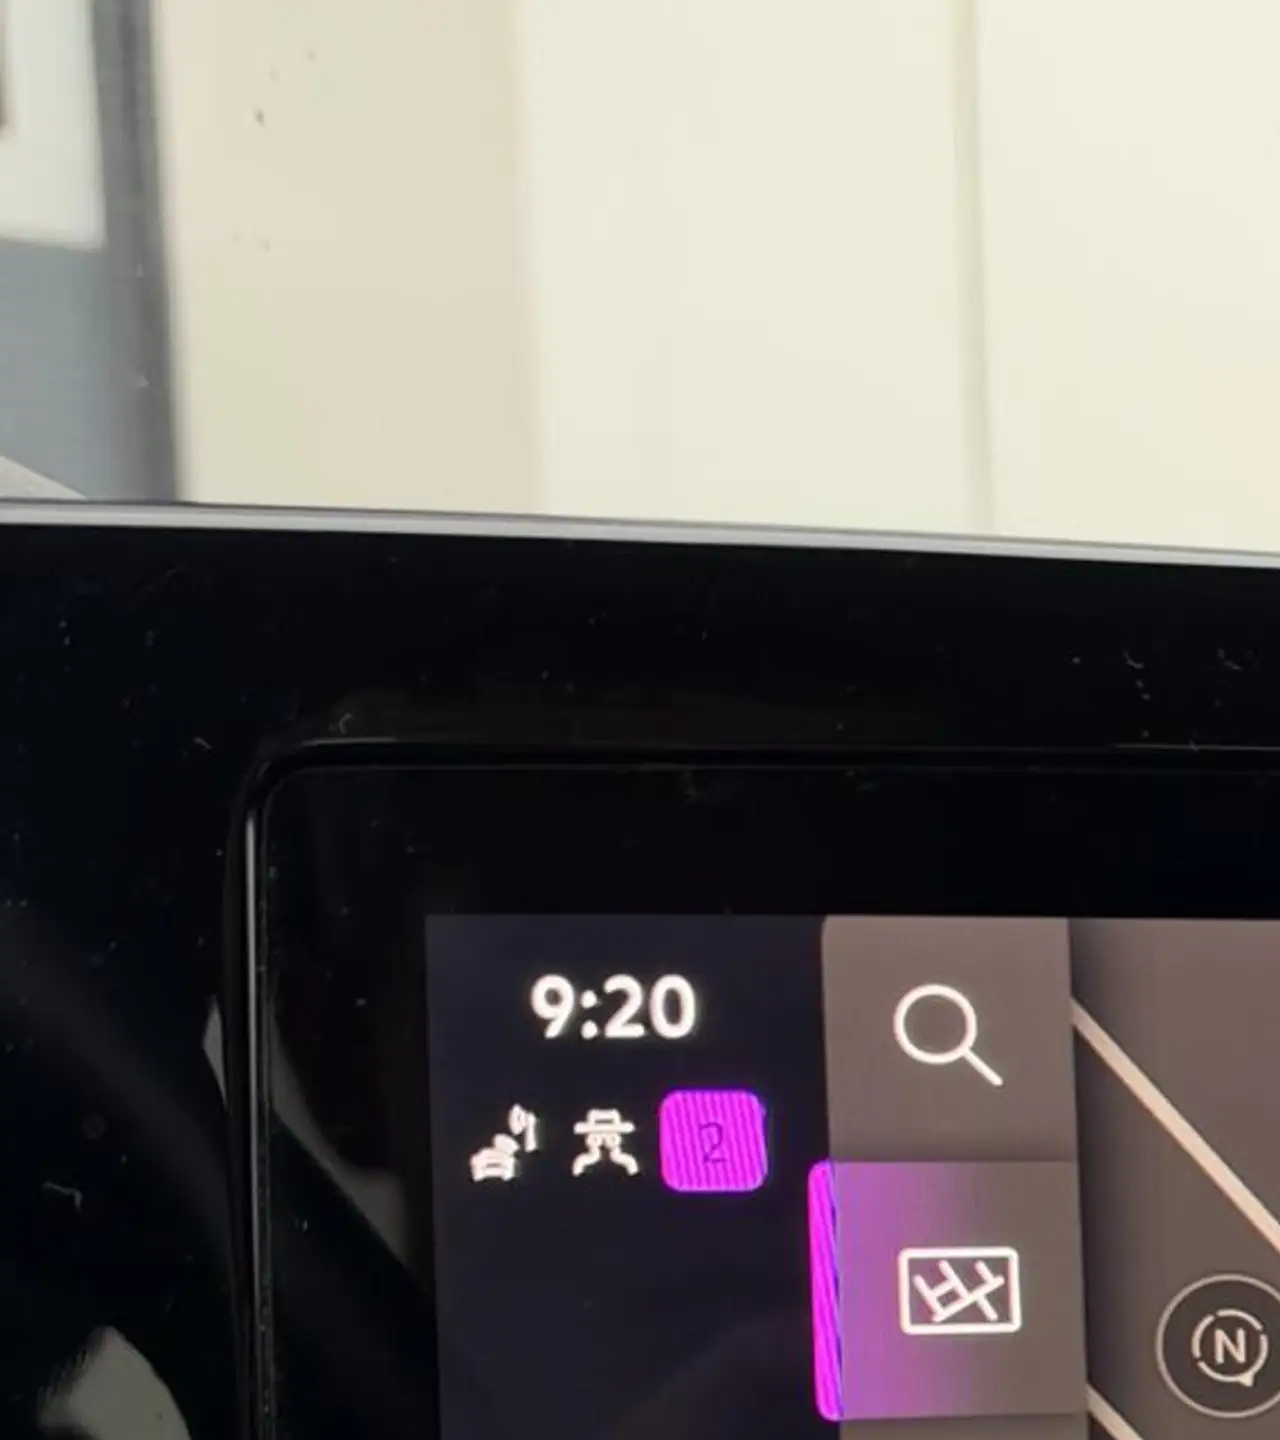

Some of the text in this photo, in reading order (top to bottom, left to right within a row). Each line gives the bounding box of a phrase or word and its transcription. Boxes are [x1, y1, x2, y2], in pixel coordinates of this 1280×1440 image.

[530, 974, 697, 1039] 9:20
[700, 1122, 728, 1164] 2
[1214, 1327, 1247, 1365] N
